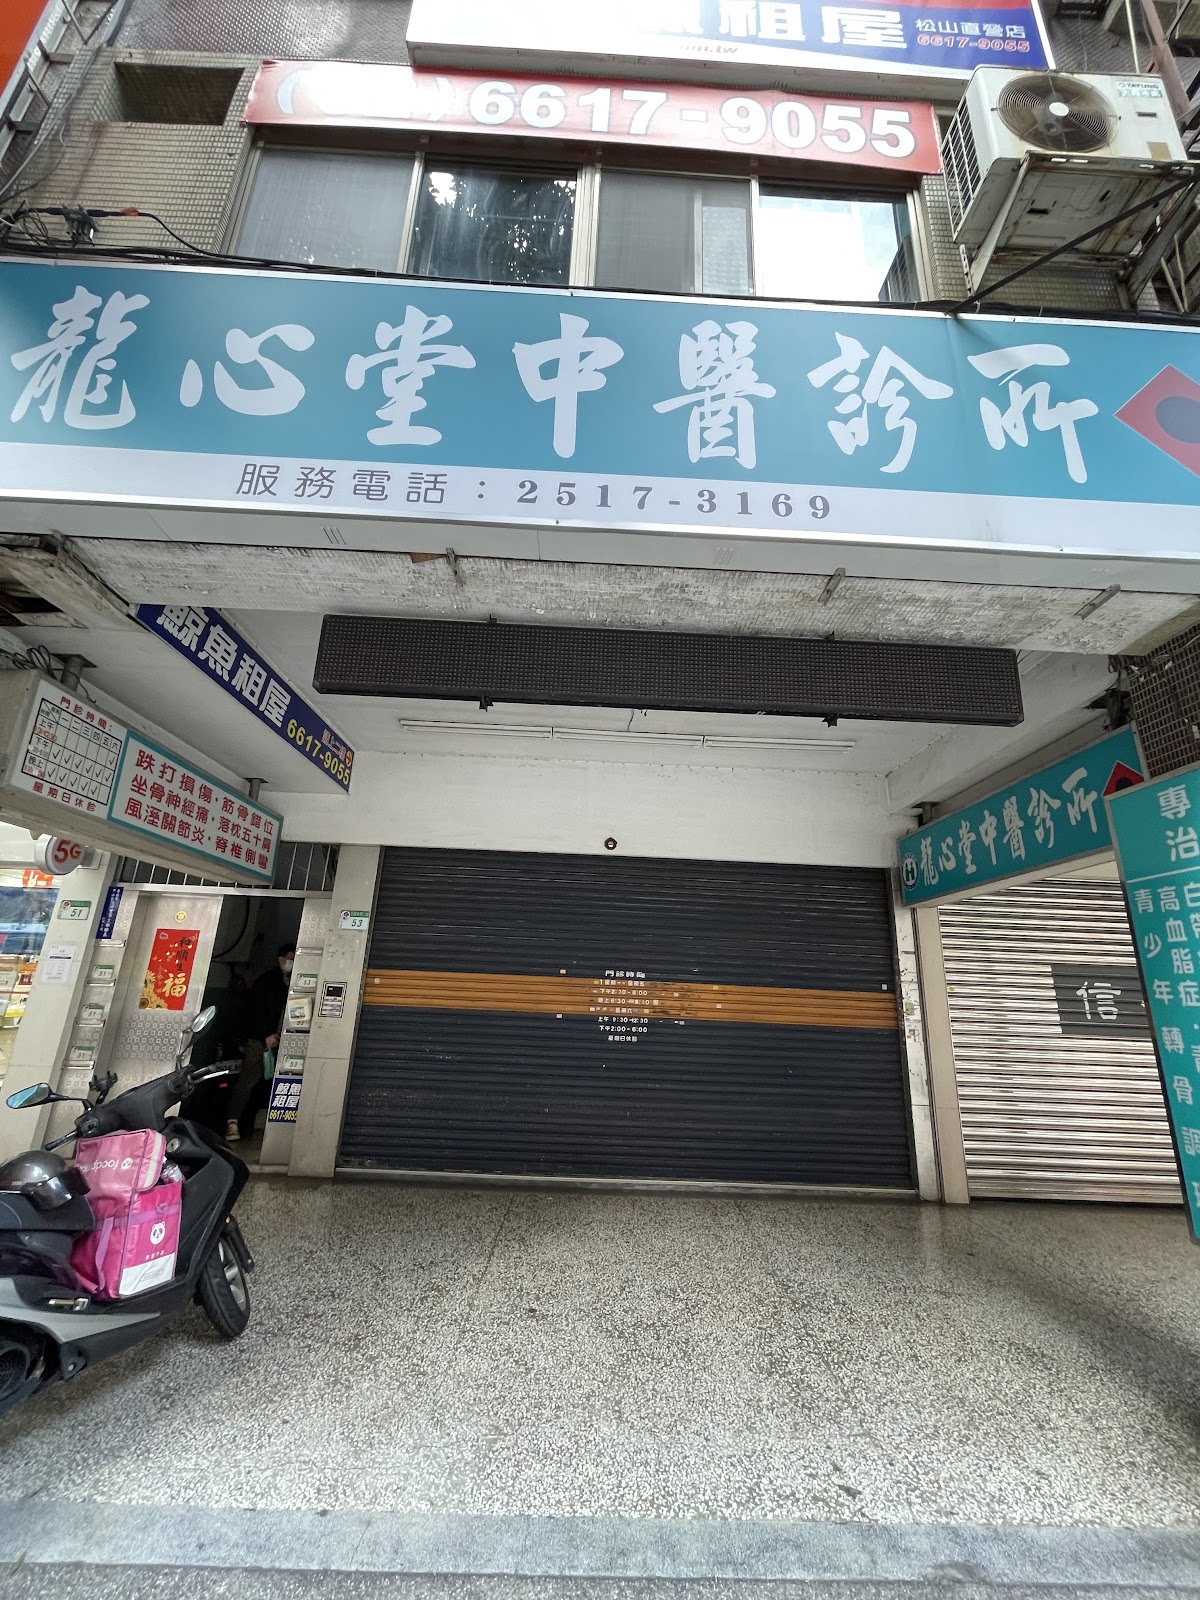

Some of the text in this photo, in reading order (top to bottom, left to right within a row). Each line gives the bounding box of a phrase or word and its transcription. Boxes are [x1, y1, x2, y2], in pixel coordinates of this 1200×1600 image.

[915, 18, 1027, 39] 松山直營店
[916, 34, 1032, 53] 6617-9055
[468, 80, 916, 159] 6617-9055
[9, 284, 1099, 484] 龍心堂中醫診所
[287, 718, 351, 785] 6617-9055
[920, 766, 1099, 887] 龍心堂中醫診所
[1156, 784, 1199, 862] 專治
[54, 839, 82, 864] 5G
[70, 908, 83, 918] 51
[351, 918, 363, 928] 53
[162, 973, 187, 997] 福
